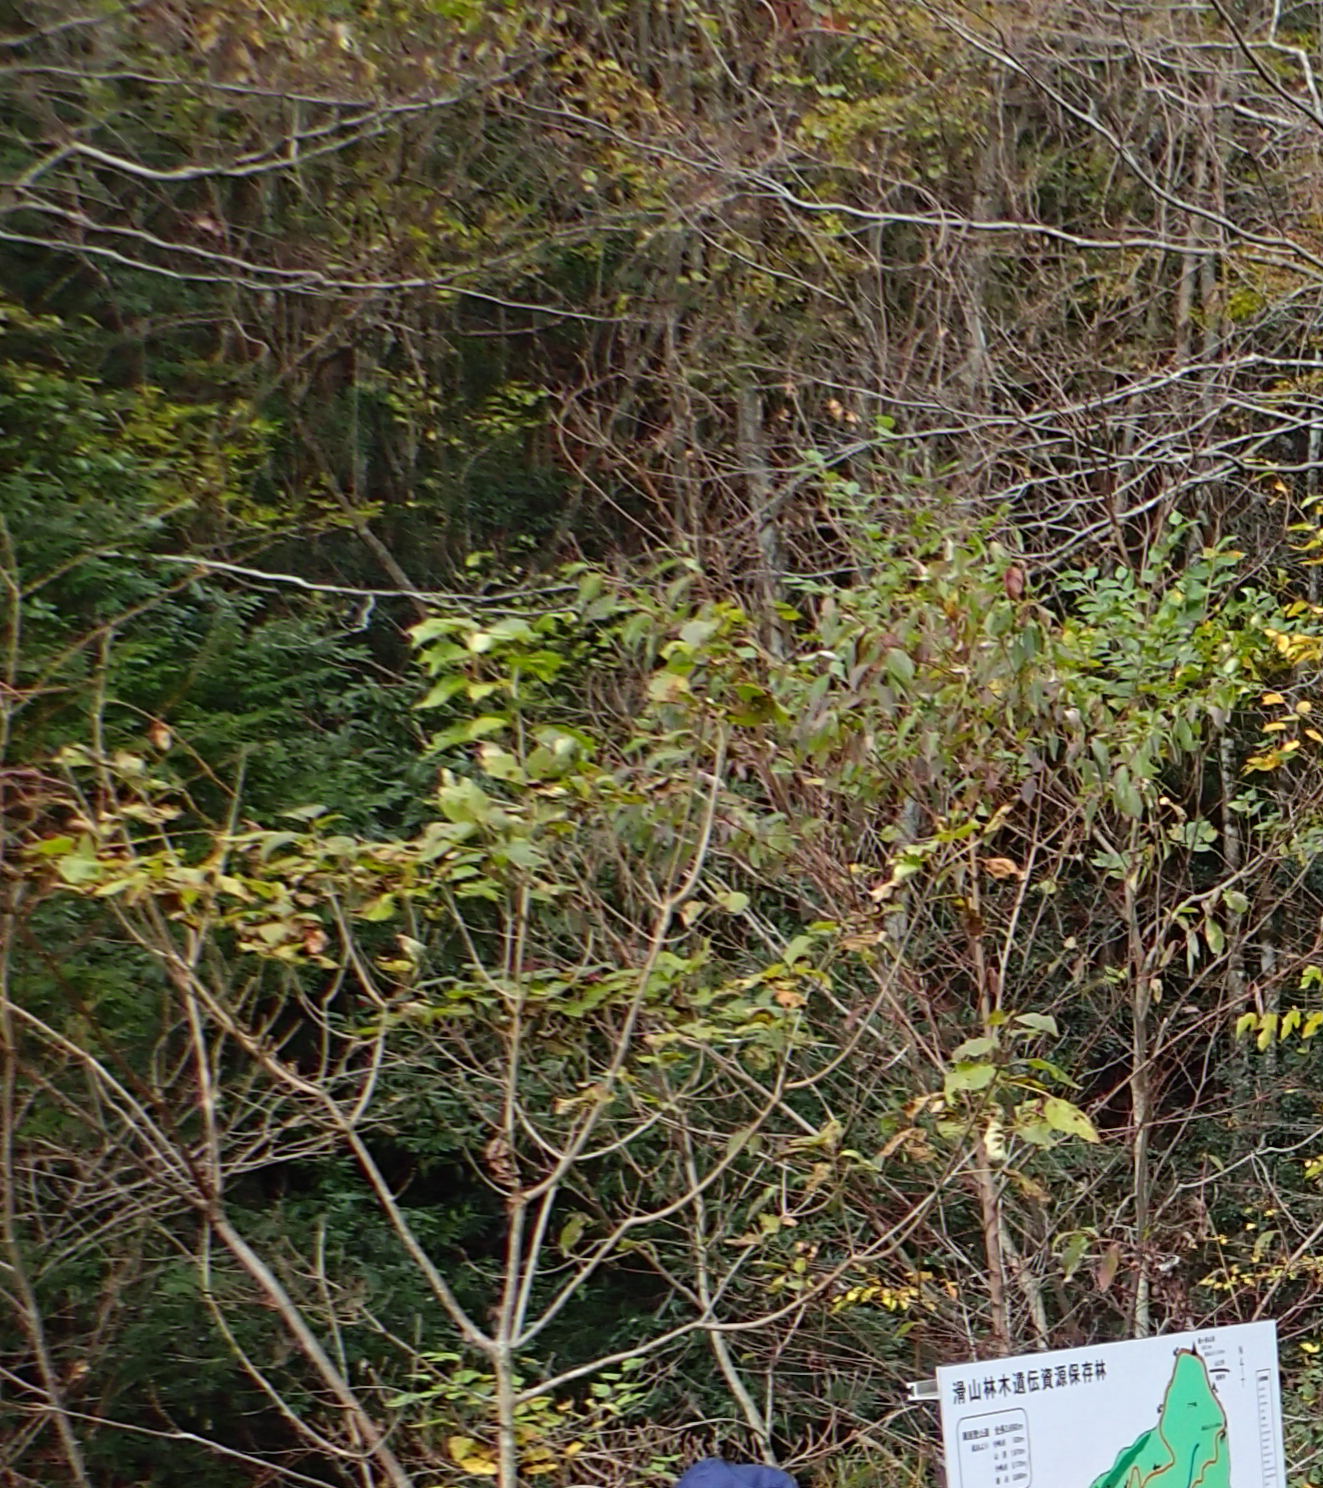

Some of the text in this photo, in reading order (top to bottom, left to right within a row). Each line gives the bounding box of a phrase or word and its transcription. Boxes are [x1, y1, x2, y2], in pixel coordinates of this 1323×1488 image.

[953, 1359, 1107, 1404] 滑山林木遺伝資源保存林
